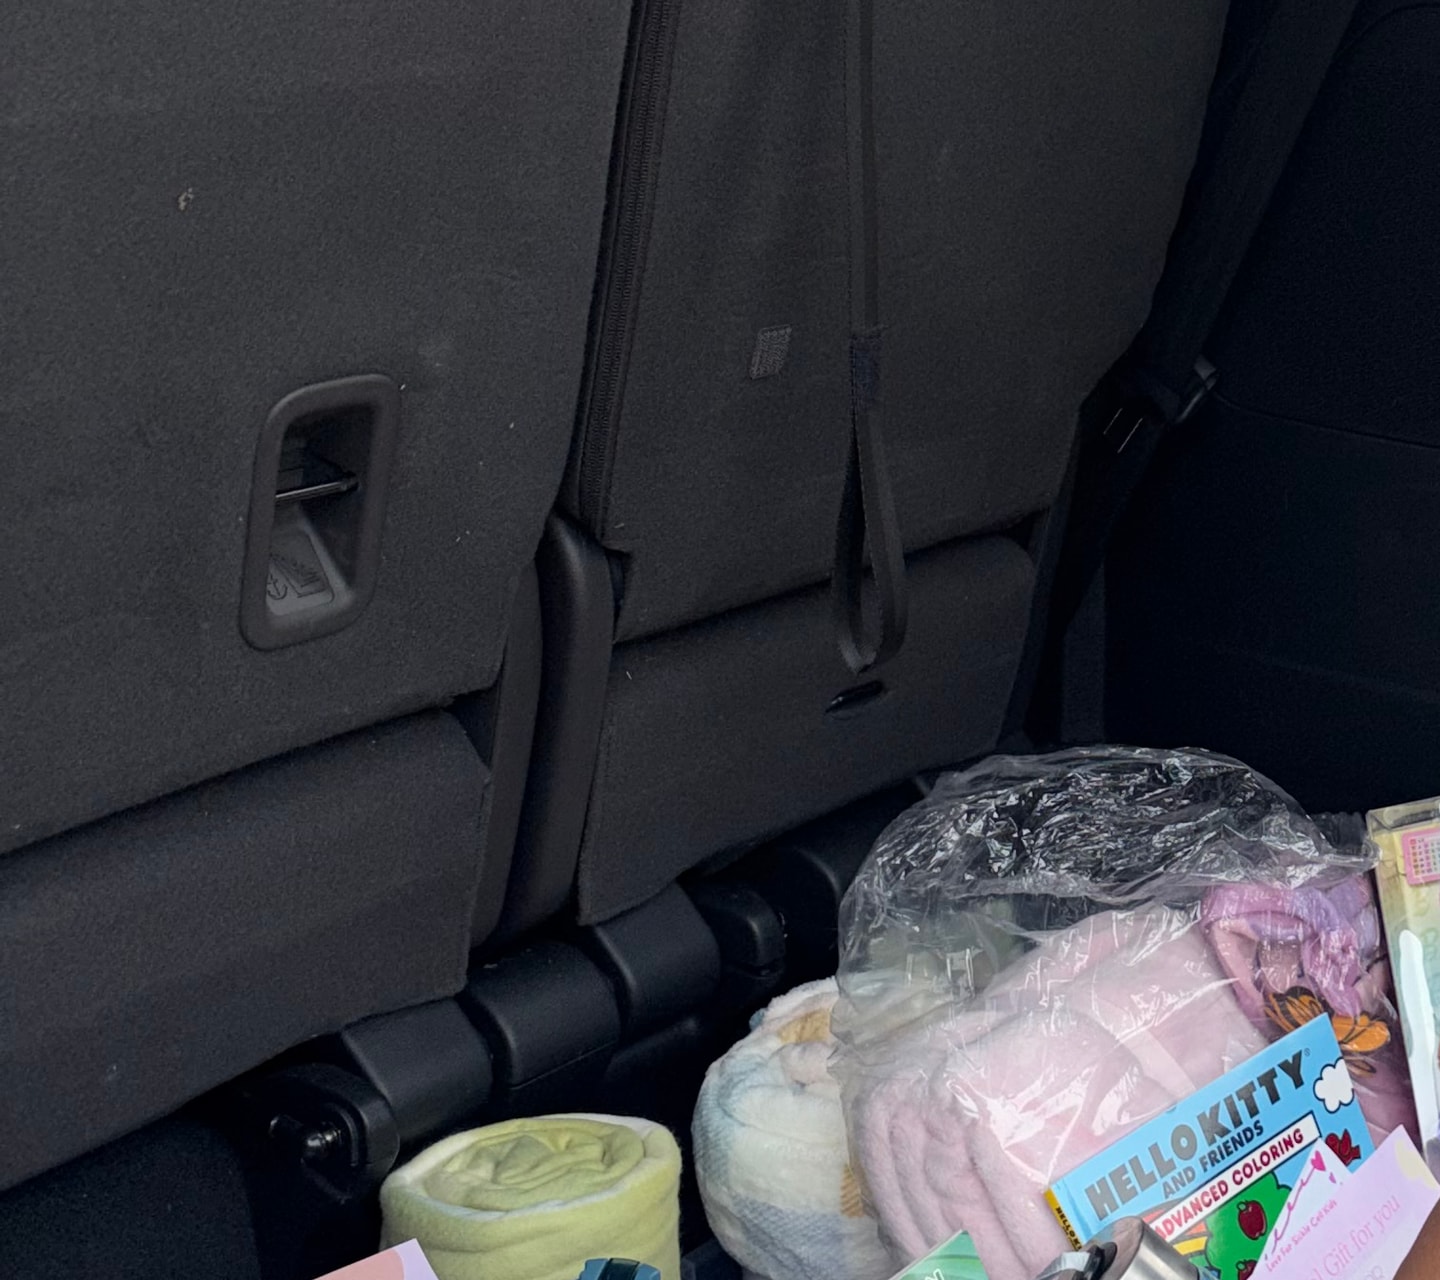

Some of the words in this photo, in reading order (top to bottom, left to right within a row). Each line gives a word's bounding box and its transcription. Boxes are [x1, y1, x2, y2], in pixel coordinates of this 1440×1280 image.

[1084, 1123, 1198, 1222] HELLO
[1197, 1049, 1305, 1147] KITTY
[1154, 1179, 1229, 1241] ADVANCED
[1231, 1128, 1304, 1186] COLORING
[1161, 1165, 1197, 1200] AND
[1198, 1119, 1264, 1173] FRIENDS
[1323, 1240, 1355, 1278] Gift
[1351, 1221, 1375, 1252] for
[1374, 1195, 1401, 1237] you
